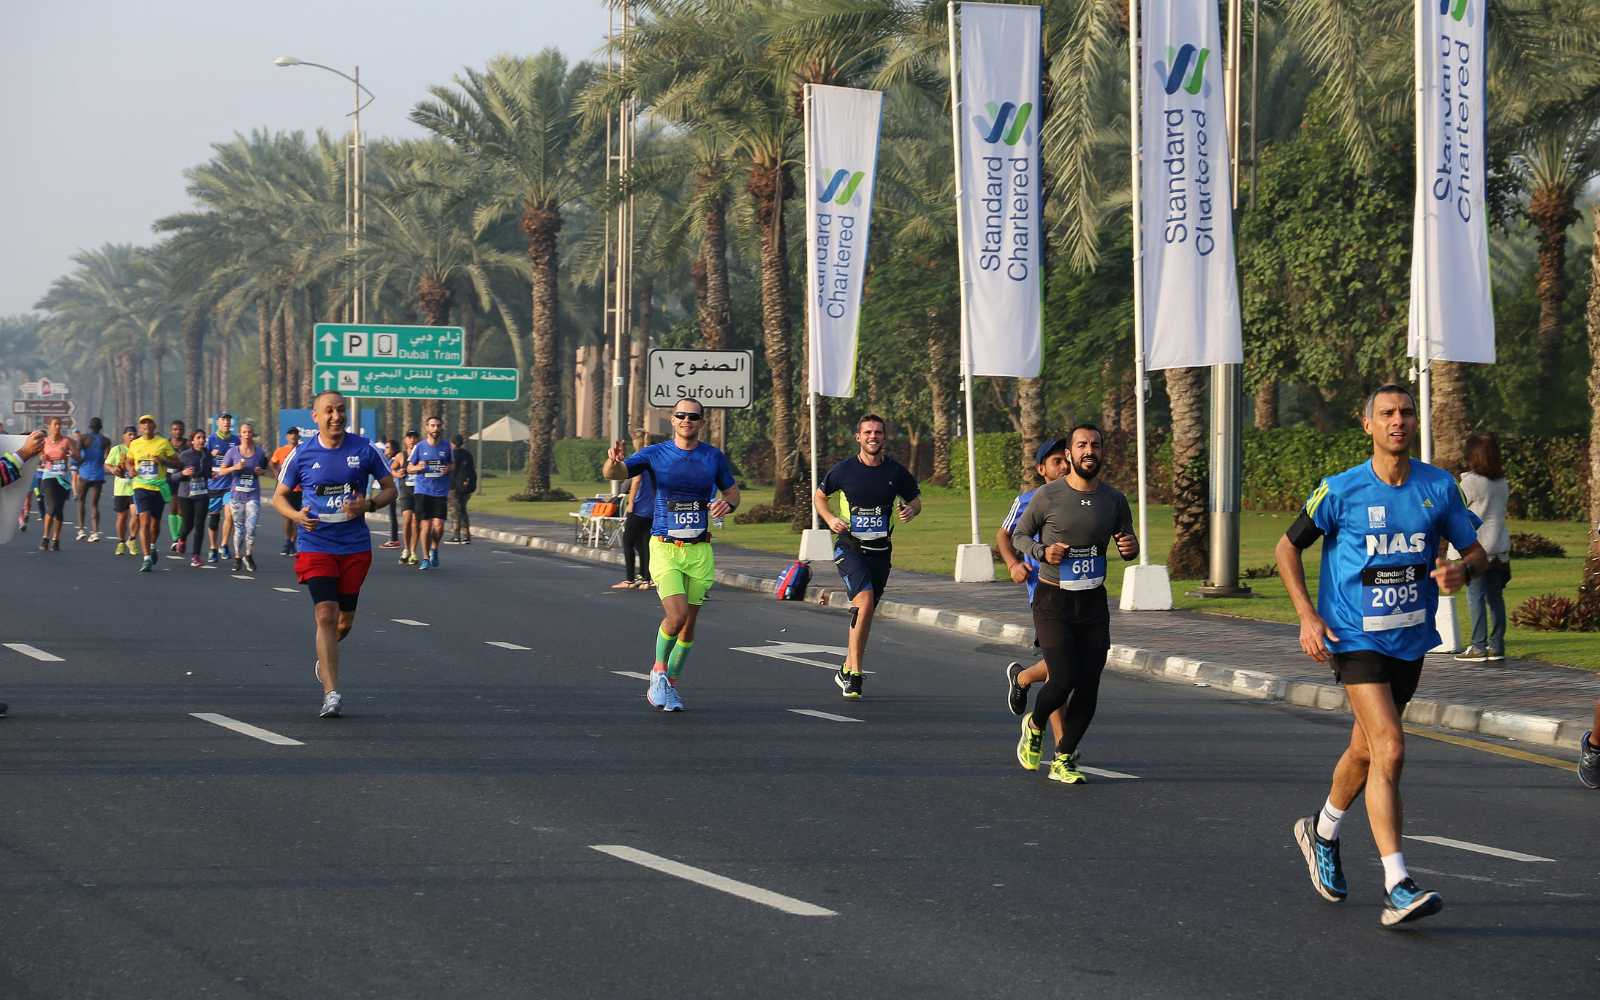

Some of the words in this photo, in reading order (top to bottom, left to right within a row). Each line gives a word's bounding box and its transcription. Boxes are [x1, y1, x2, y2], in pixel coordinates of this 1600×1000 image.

[1455, 40, 1471, 223] Chartered
[1164, 108, 1188, 244] Standard
[1192, 109, 1215, 257] Chartered
[979, 156, 1003, 272] Standard
[1007, 157, 1029, 282] Chartered
[827, 215, 855, 319] Chartered
[349, 335, 362, 354] P
[410, 333, 433, 347] دبي
[438, 331, 461, 347] ترام
[399, 348, 429, 359] Dubai
[433, 349, 460, 360] Tram
[674, 357, 744, 377] الصفوح
[360, 384, 370, 393] Al
[374, 384, 406, 394] Sufouh
[408, 386, 438, 395] Marine
[655, 384, 671, 398] Al
[676, 385, 734, 399] Sufouh
[739, 385, 745, 398] 1
[674, 512, 700, 525] 1653
[856, 516, 883, 528] 2256
[1365, 533, 1426, 556] NAS
[1072, 558, 1095, 574] 681
[1371, 583, 1418, 608] 2095
